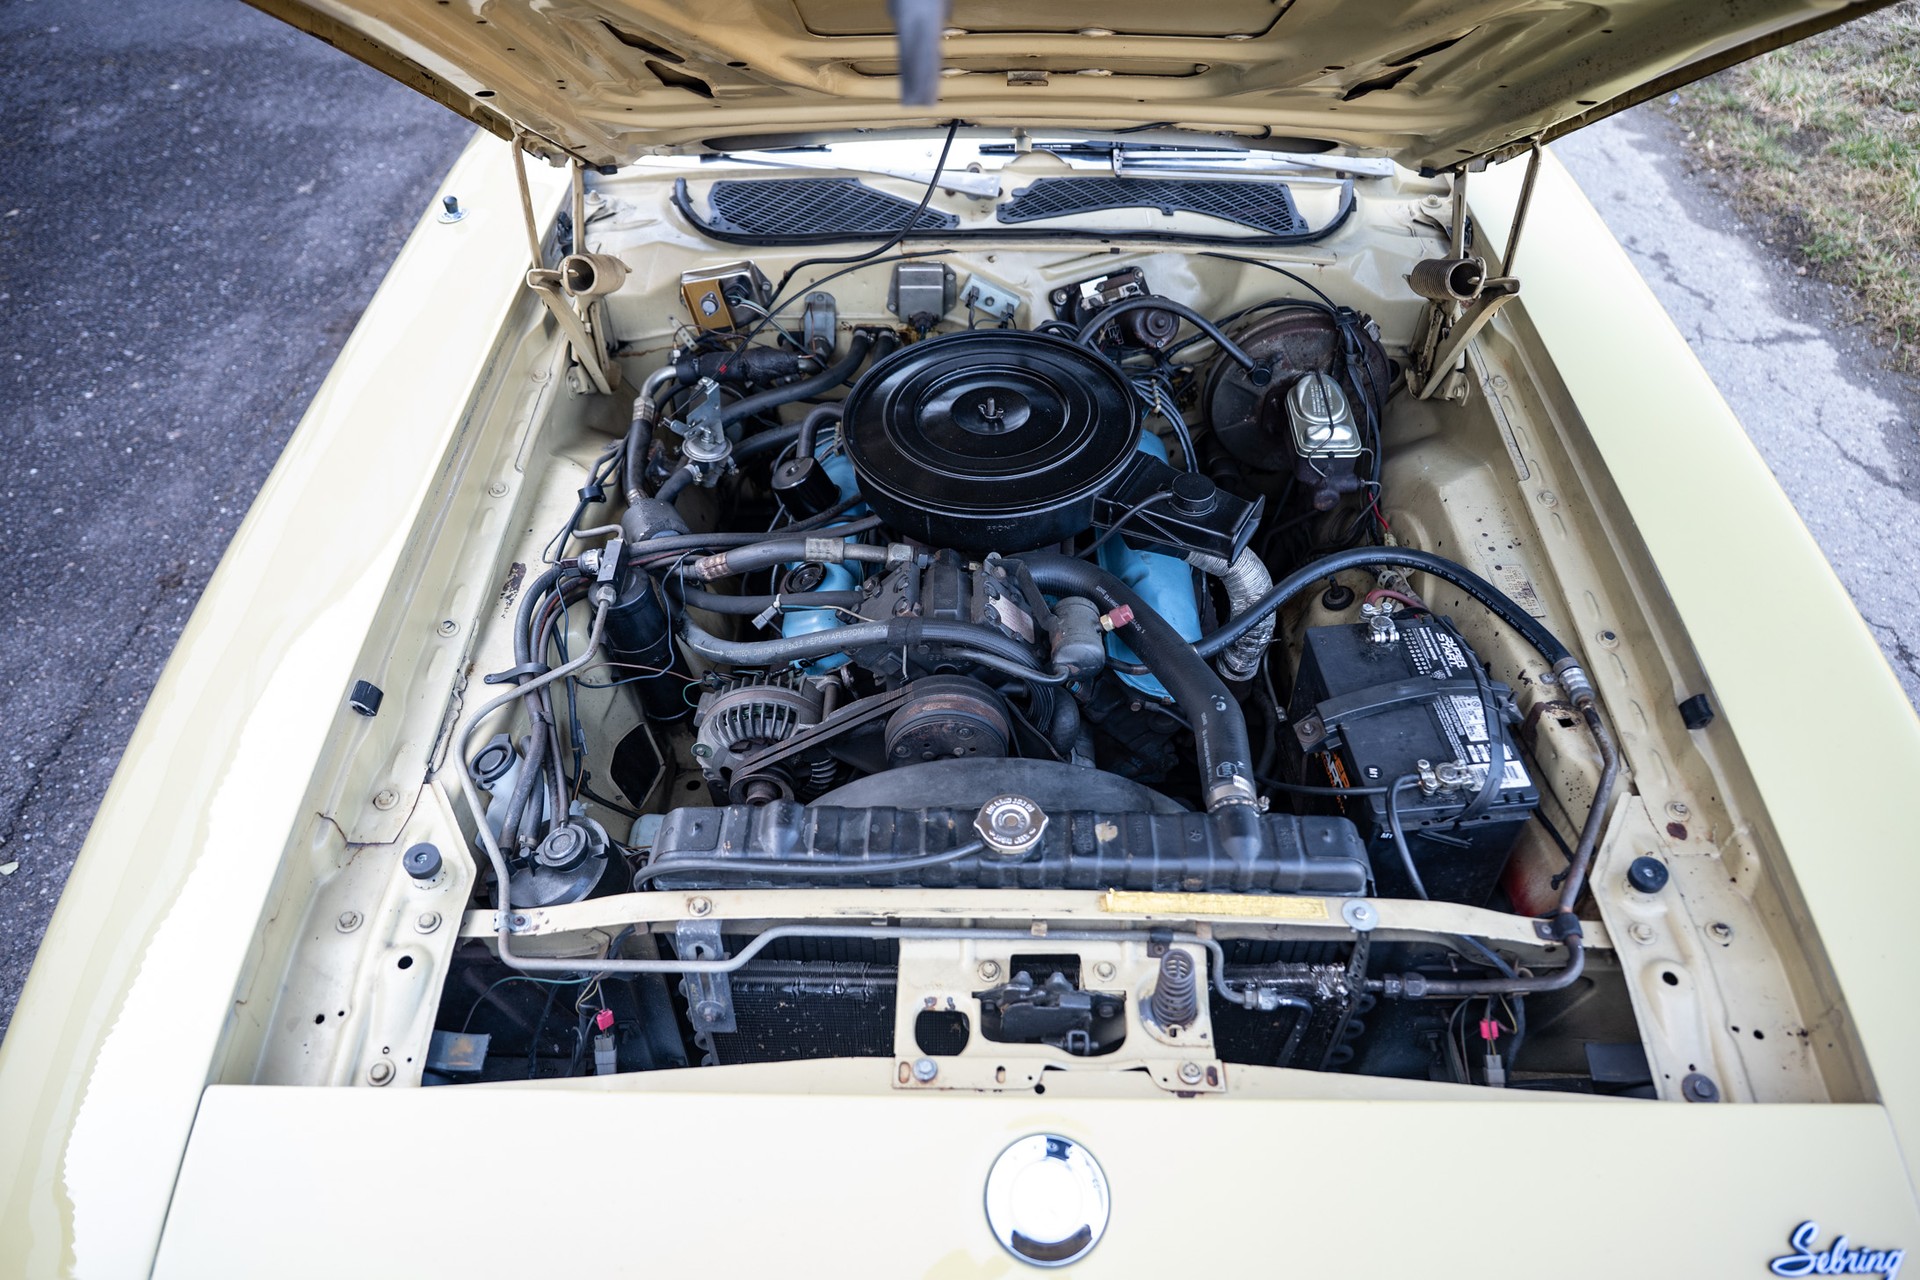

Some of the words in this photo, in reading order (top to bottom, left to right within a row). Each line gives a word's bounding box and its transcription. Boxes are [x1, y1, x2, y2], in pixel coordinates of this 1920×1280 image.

[1435, 632, 1462, 670] START
[1368, 767, 1378, 778] M1
[1768, 1219, 1906, 1280] Sebring
